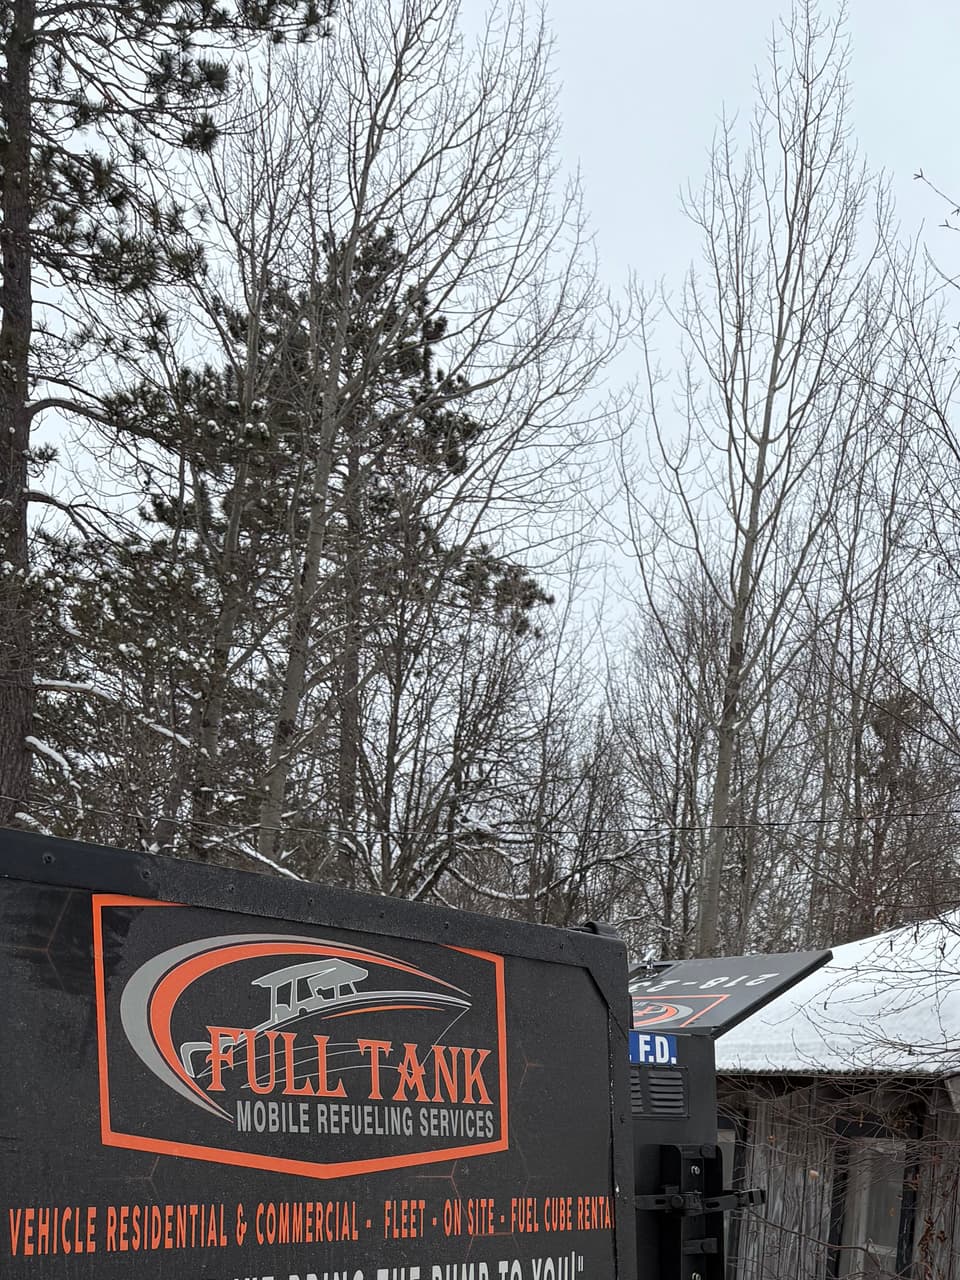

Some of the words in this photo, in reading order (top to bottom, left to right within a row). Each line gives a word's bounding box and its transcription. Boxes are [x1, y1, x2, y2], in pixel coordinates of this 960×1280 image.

[206, 1025, 347, 1099] FULL
[358, 1039, 494, 1105] TANK
[639, 1034, 677, 1065] F.D.
[236, 1100, 311, 1135] MOBILE
[317, 1102, 414, 1137] REFUELING
[419, 1106, 495, 1139] SERVICES
[9, 1206, 97, 1256] VEHICLE
[106, 1203, 228, 1251] RESIDENTIAL
[236, 1203, 248, 1246] &
[255, 1201, 359, 1245] COMMERCIAL
[384, 1199, 426, 1240] FLEET
[443, 1199, 462, 1236] ON
[468, 1198, 495, 1235] SITE
[511, 1198, 539, 1233] FUEL
[544, 1197, 573, 1231] CUBE
